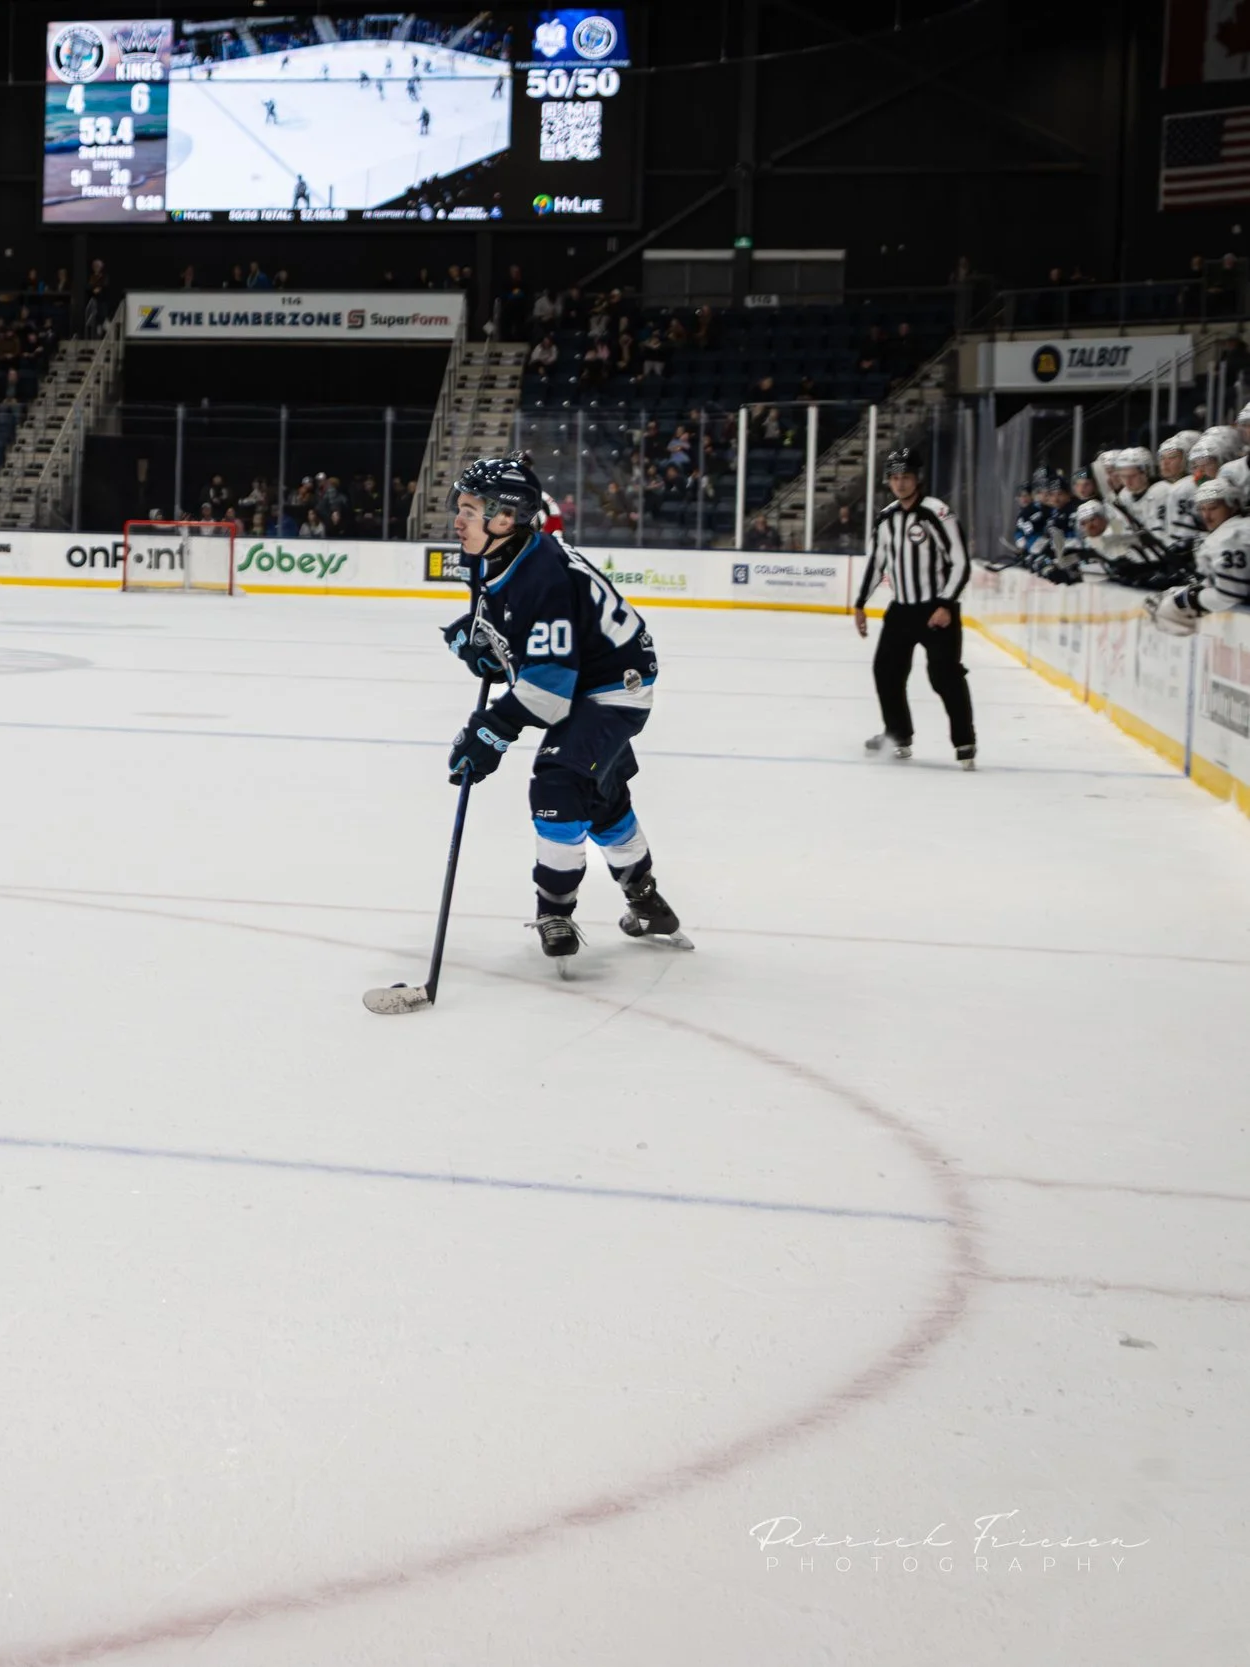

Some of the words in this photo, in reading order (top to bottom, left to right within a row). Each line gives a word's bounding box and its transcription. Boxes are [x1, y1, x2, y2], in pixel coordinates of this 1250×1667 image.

[115, 61, 165, 80] KINGS
[526, 67, 621, 98] 50/50
[65, 84, 86, 114] 4
[130, 82, 151, 114] 6
[78, 116, 135, 145] 53.4
[81, 185, 129, 197] PENALTIES
[169, 311, 203, 326] THE
[209, 311, 342, 327] LUMBERZONE
[1067, 346, 1132, 367] TALBOT
[237, 542, 348, 579] Sobeys
[1222, 550, 1247, 569] 33
[527, 619, 573, 656] 20
